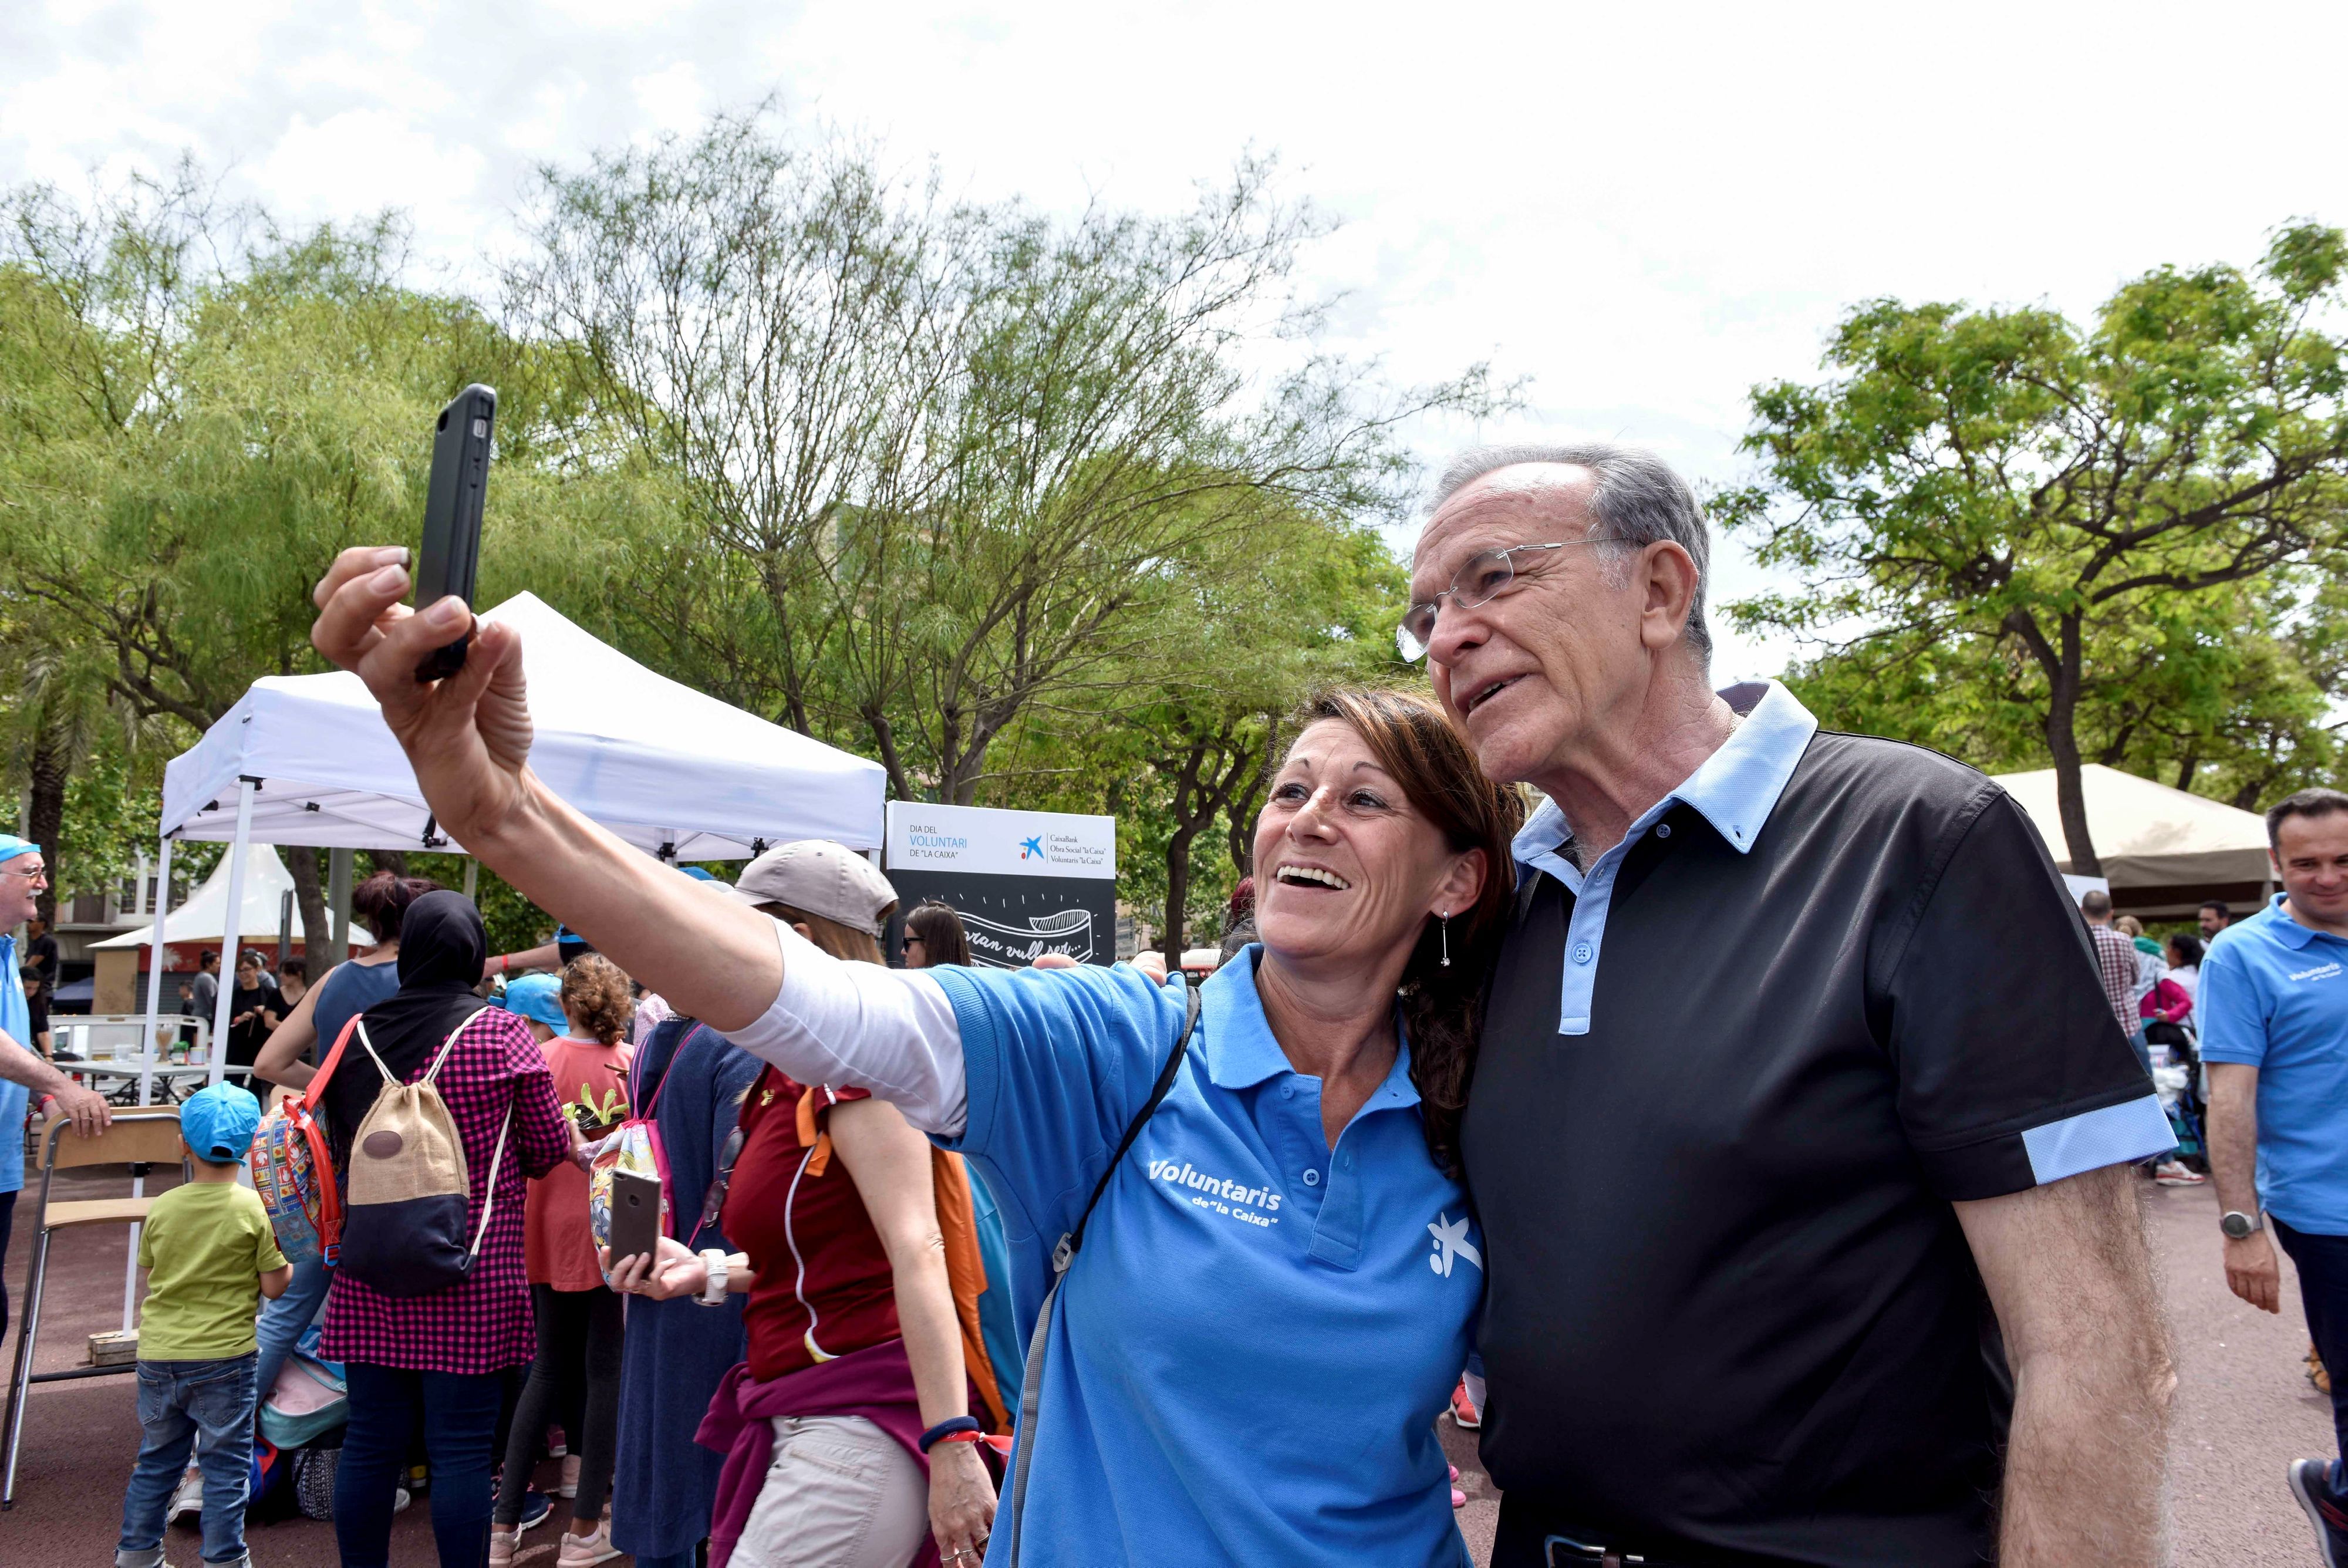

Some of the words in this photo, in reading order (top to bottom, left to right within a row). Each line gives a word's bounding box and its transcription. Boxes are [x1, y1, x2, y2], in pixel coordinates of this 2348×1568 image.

[910, 835, 967, 848] VOLUNTARI
[1050, 834, 1078, 842] CaixaBank
[921, 849, 933, 858] "LA
[1051, 855, 1078, 864] Voluntaris
[1149, 1160, 1282, 1210] Voluntaris
